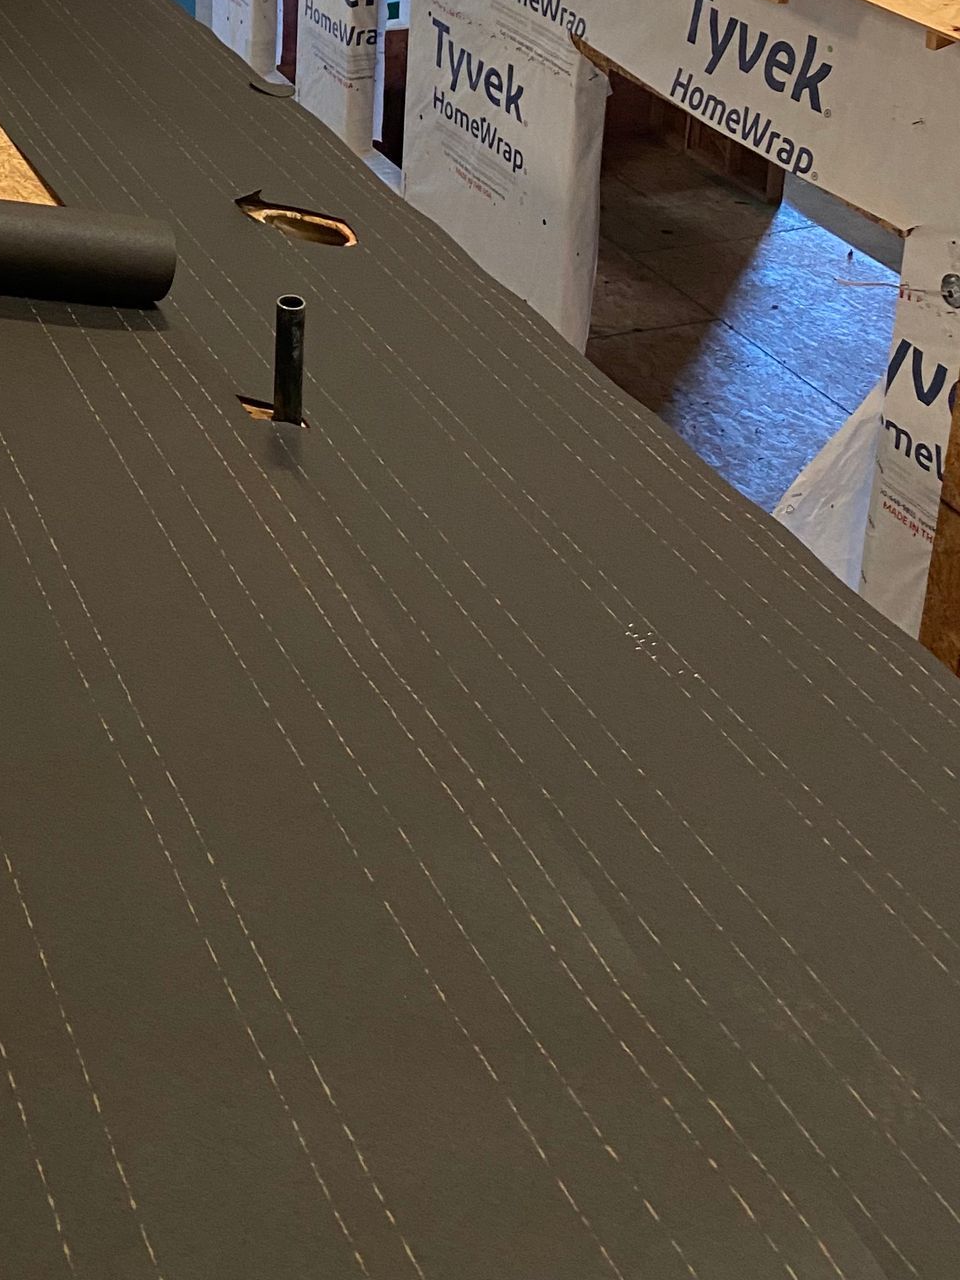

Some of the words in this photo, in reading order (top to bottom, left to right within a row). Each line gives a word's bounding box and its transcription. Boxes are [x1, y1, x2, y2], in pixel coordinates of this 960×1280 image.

[432, 17, 524, 123] Tyvek
[670, 67, 814, 175] HomeWrap
[433, 86, 524, 172] HomeWrap
